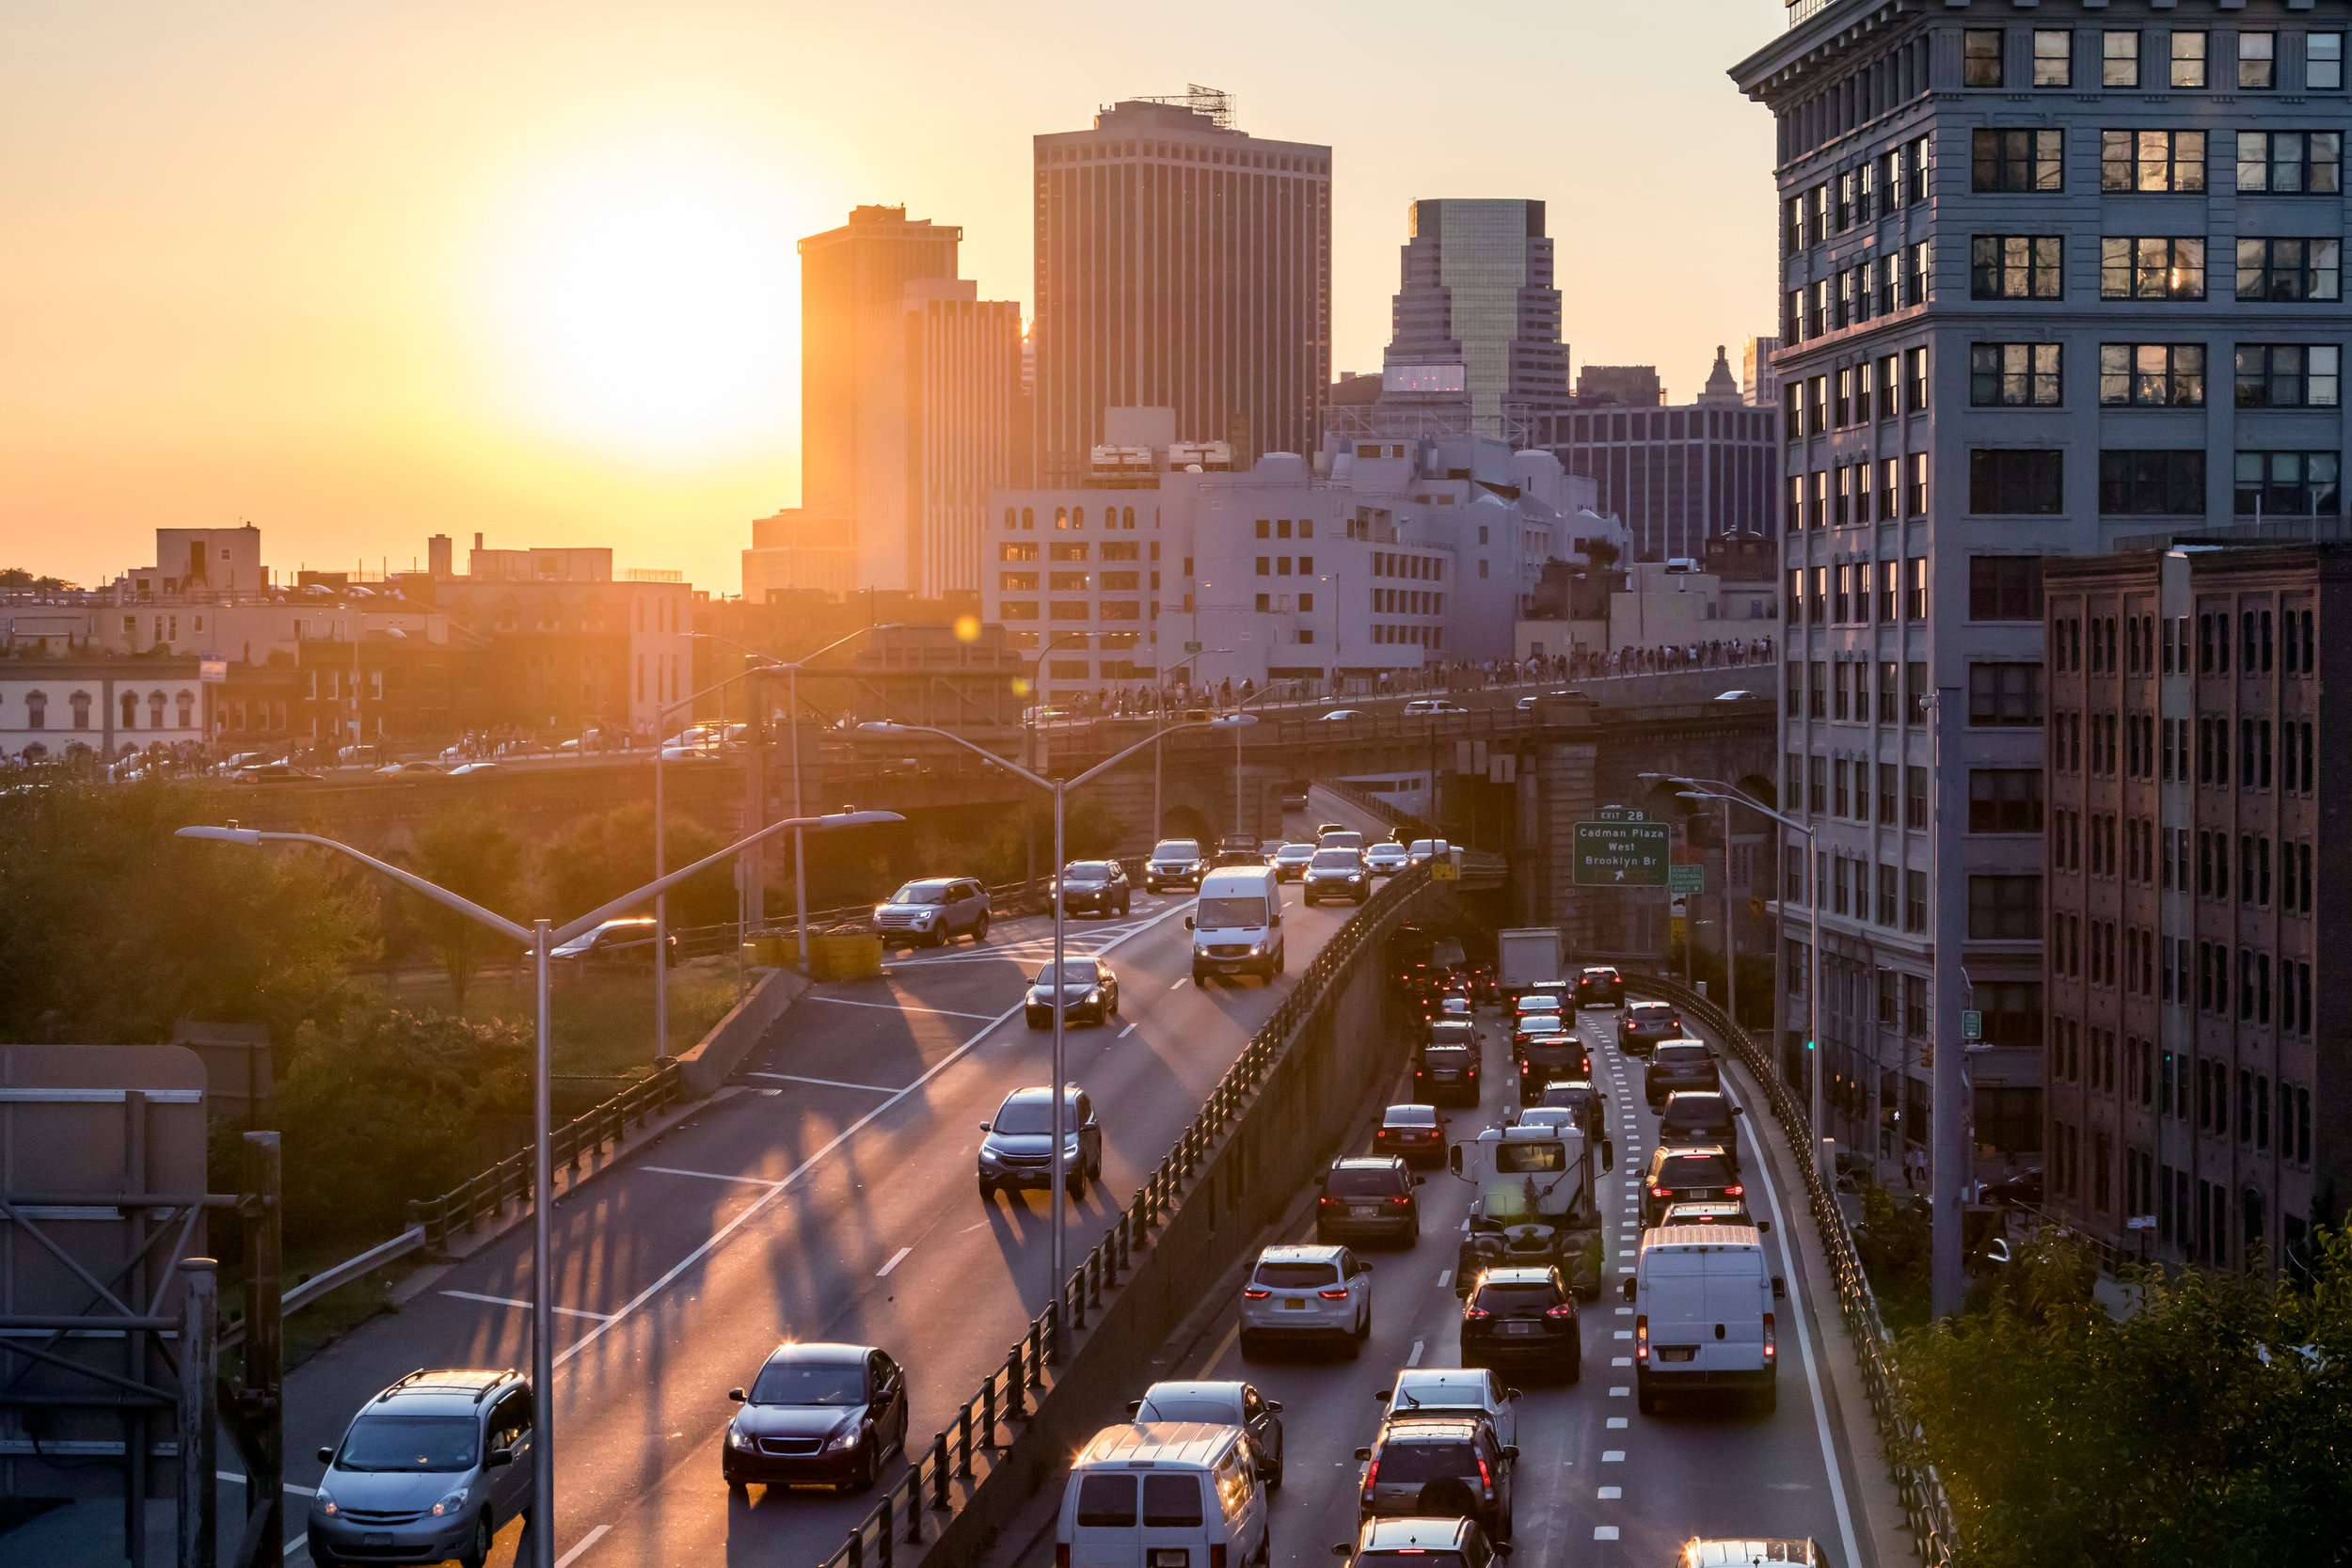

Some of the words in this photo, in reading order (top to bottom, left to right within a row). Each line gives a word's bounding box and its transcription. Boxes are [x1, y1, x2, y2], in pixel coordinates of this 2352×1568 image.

[1580, 829, 1627, 837] Cadman
[1632, 829, 1664, 838] Plaza
[1609, 843, 1635, 851] West
[1585, 856, 1638, 867] Brooklyn
